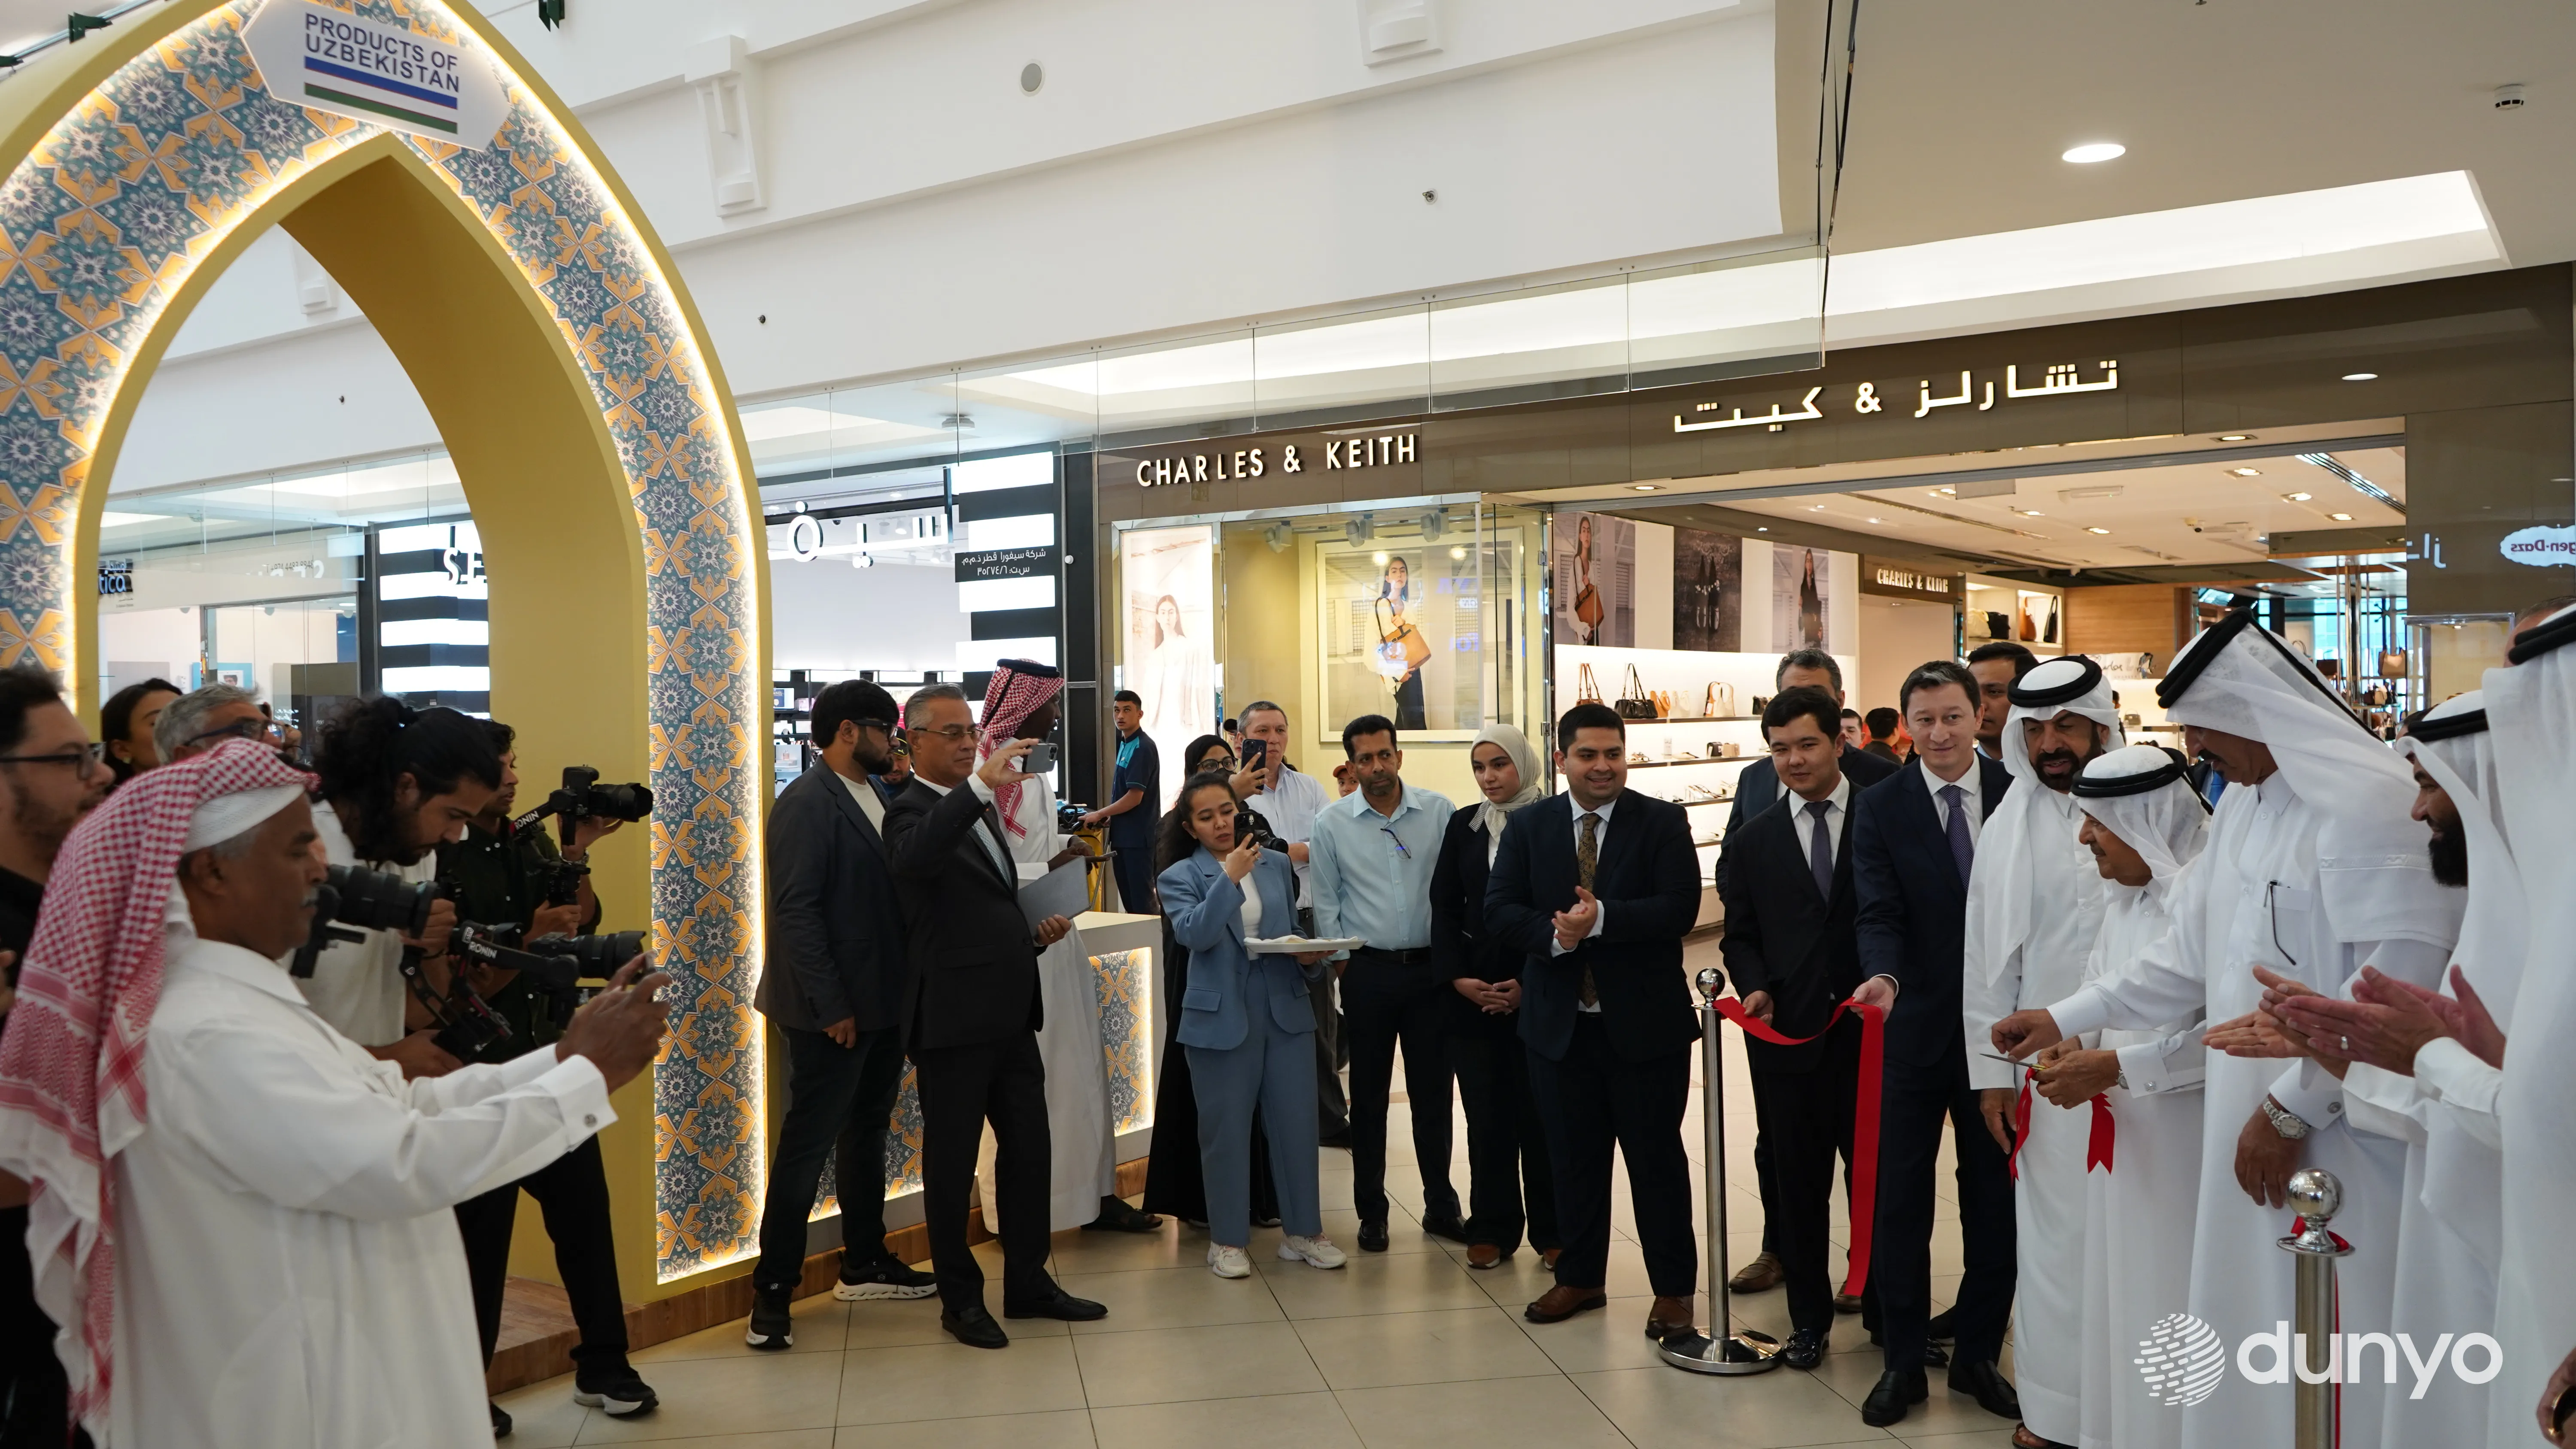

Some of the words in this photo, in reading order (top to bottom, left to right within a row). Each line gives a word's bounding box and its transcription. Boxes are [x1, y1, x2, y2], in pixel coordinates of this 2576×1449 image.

[305, 12, 424, 62] PRODUCTS
[431, 51, 458, 72] OF
[305, 33, 460, 93] UZBEKISTAN
[1855, 382, 1882, 414] &
[1914, 360, 2118, 418] تشارلز
[1137, 448, 1264, 487] CHARLES
[1283, 445, 1302, 473] &
[1325, 433, 1416, 470] KEITH
[982, 552, 997, 564] قطر
[1000, 552, 1024, 562] سيفورا
[1025, 548, 1046, 560] شركة
[1877, 568, 1914, 588] CHARLES
[1917, 575, 1923, 590] &
[1926, 576, 1948, 593] KEITH
[468, 941, 498, 959] RONIN
